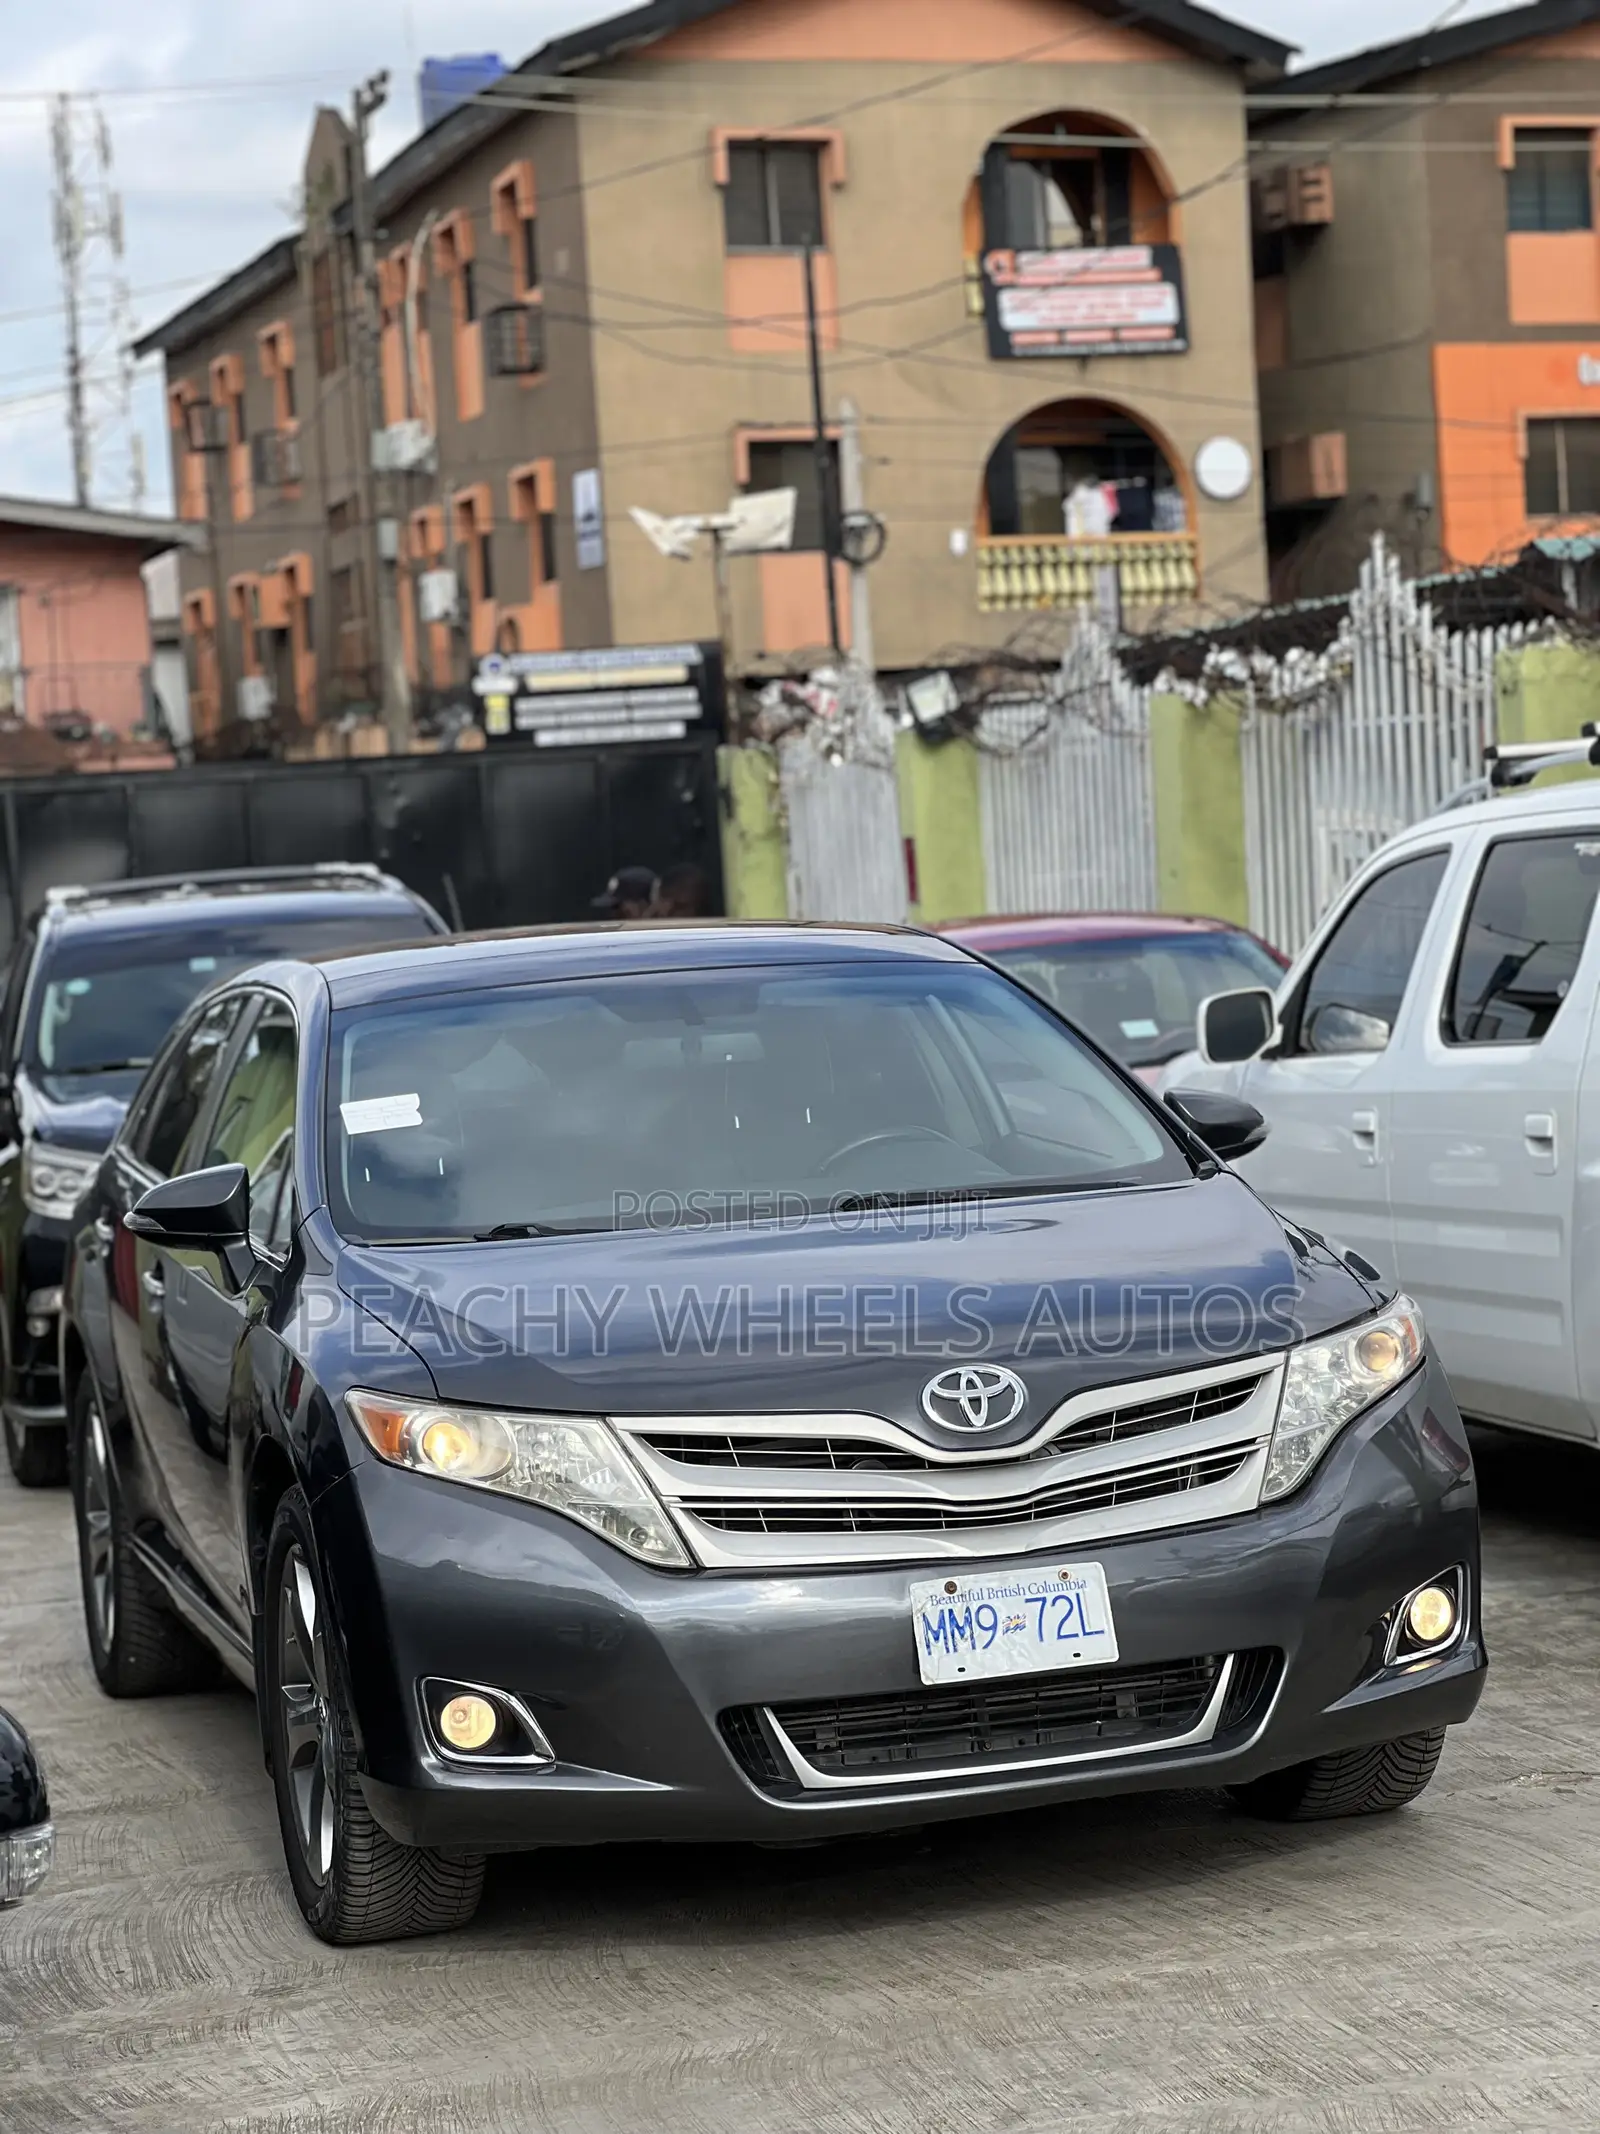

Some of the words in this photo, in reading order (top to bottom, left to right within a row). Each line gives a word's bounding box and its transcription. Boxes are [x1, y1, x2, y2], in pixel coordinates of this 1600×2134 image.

[930, 1587, 985, 1607] Beautiful
[987, 1582, 1026, 1600] British
[1027, 1578, 1088, 1595] Columbia
[922, 1603, 998, 1656] MM9
[1024, 1592, 1105, 1643] 72L
